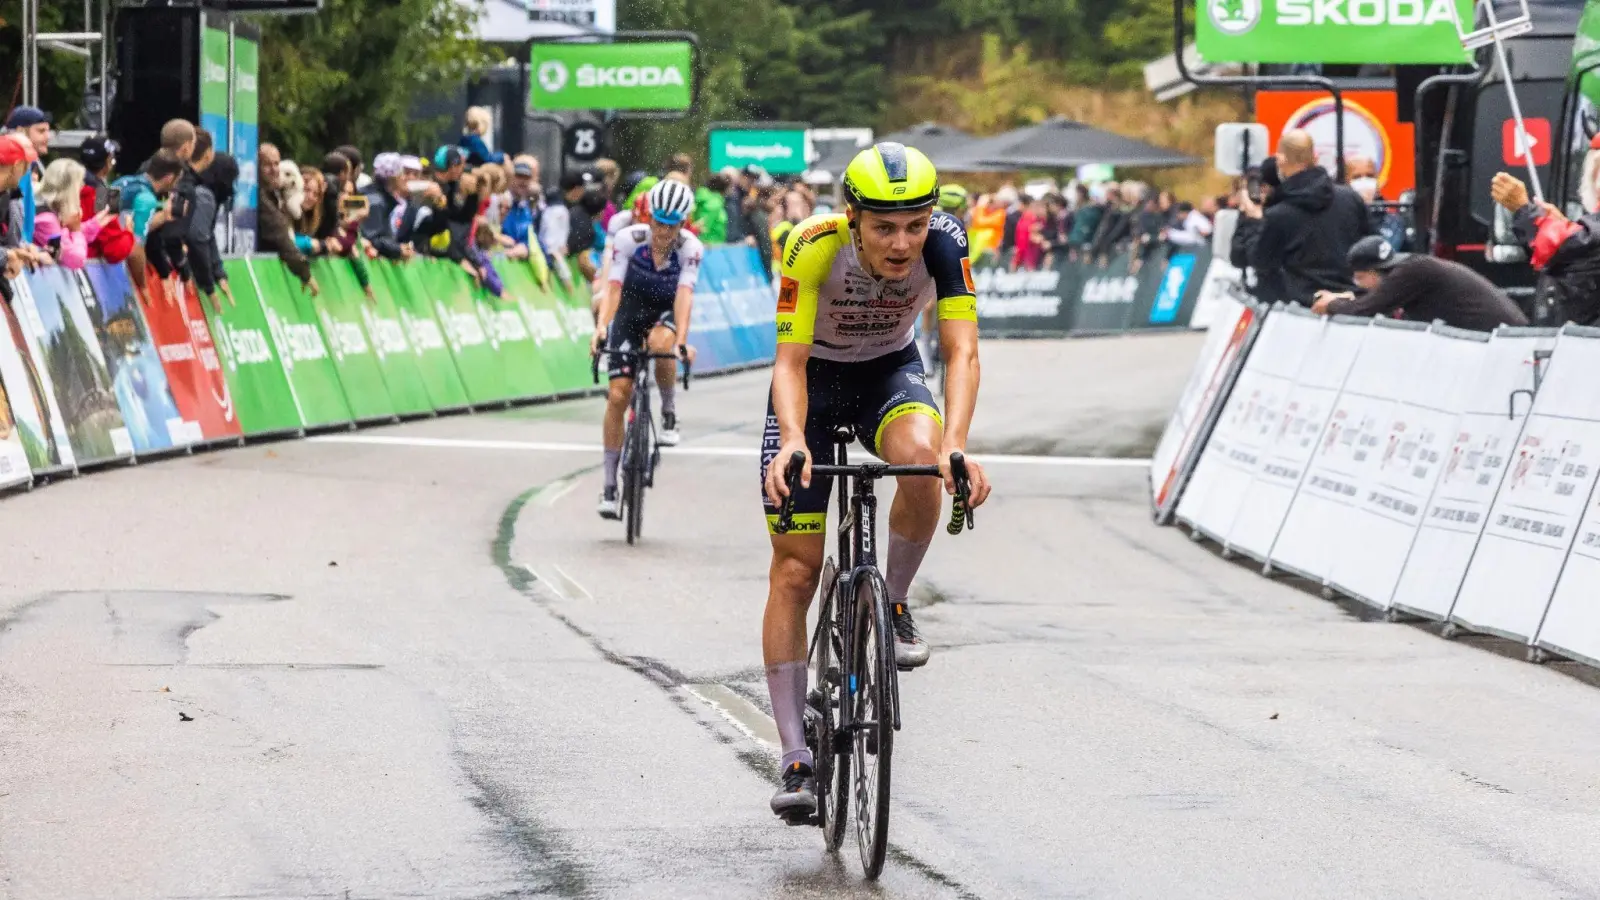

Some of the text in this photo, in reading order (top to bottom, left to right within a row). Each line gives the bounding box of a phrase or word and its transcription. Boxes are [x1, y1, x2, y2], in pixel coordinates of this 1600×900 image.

[576, 64, 684, 87] ŠKODA
[928, 214, 968, 247] allonie
[862, 504, 871, 552] CUBE
